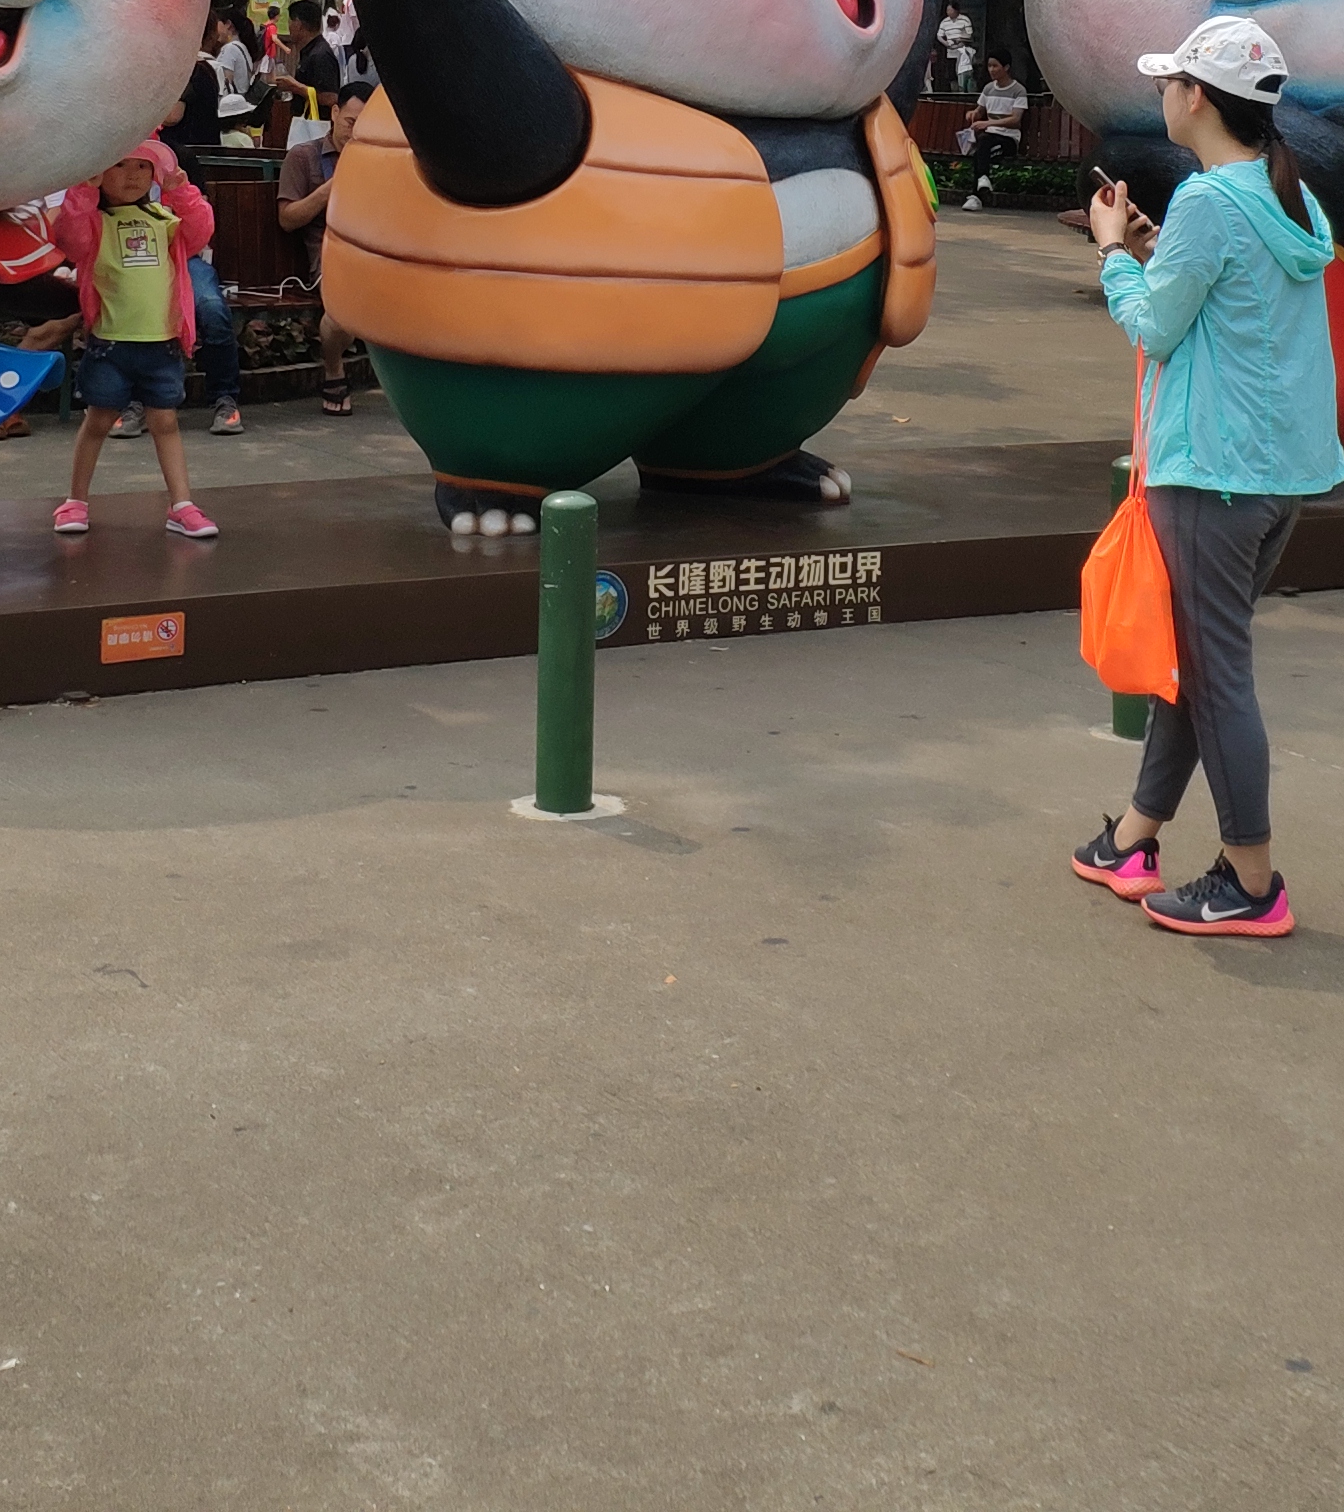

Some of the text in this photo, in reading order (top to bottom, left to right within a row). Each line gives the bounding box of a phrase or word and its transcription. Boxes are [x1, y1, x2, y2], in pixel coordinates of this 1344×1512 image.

[647, 551, 882, 599] 长隆野生动物世界
[647, 586, 881, 619] CHIMELONG SAFARI PARK
[646, 606, 882, 640] 世界级野生动物王国
